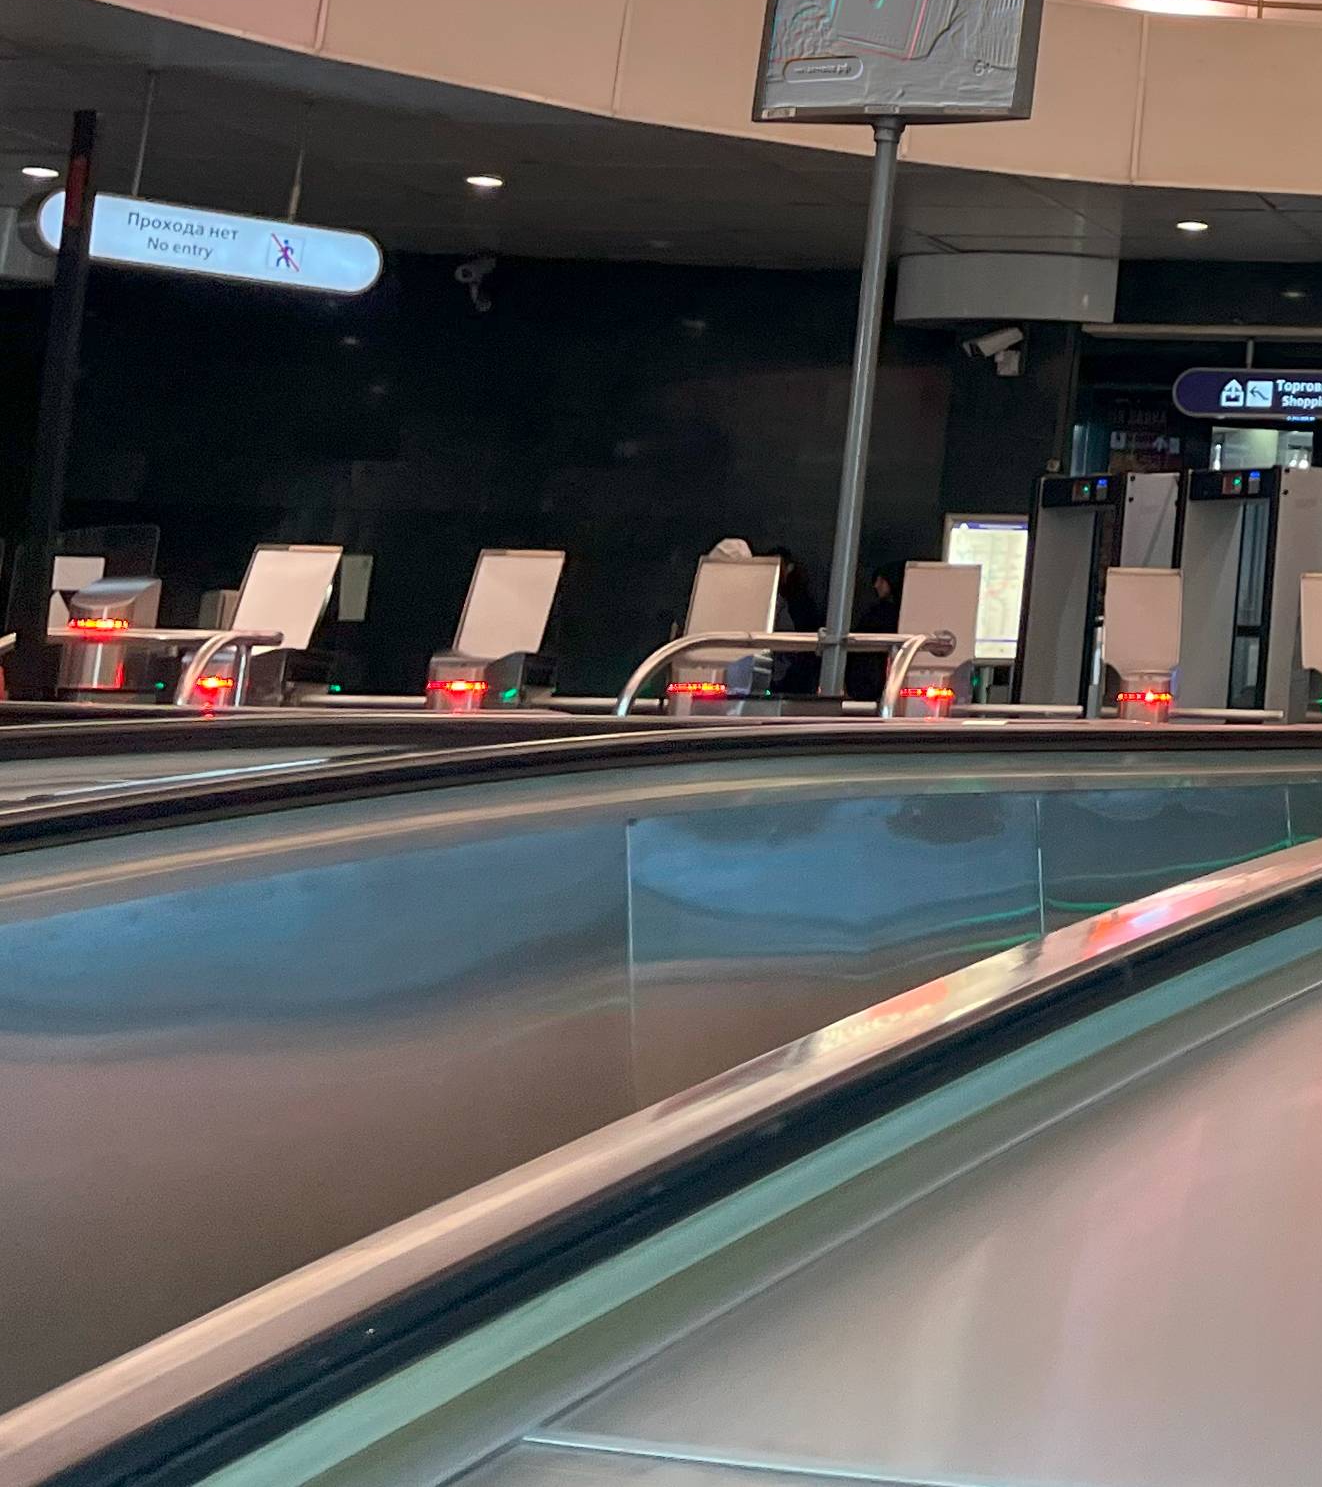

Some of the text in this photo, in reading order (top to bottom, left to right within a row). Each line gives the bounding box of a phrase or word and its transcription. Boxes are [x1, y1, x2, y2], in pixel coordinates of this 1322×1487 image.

[127, 211, 239, 241] Прохода нет
[147, 236, 213, 260] No entry
